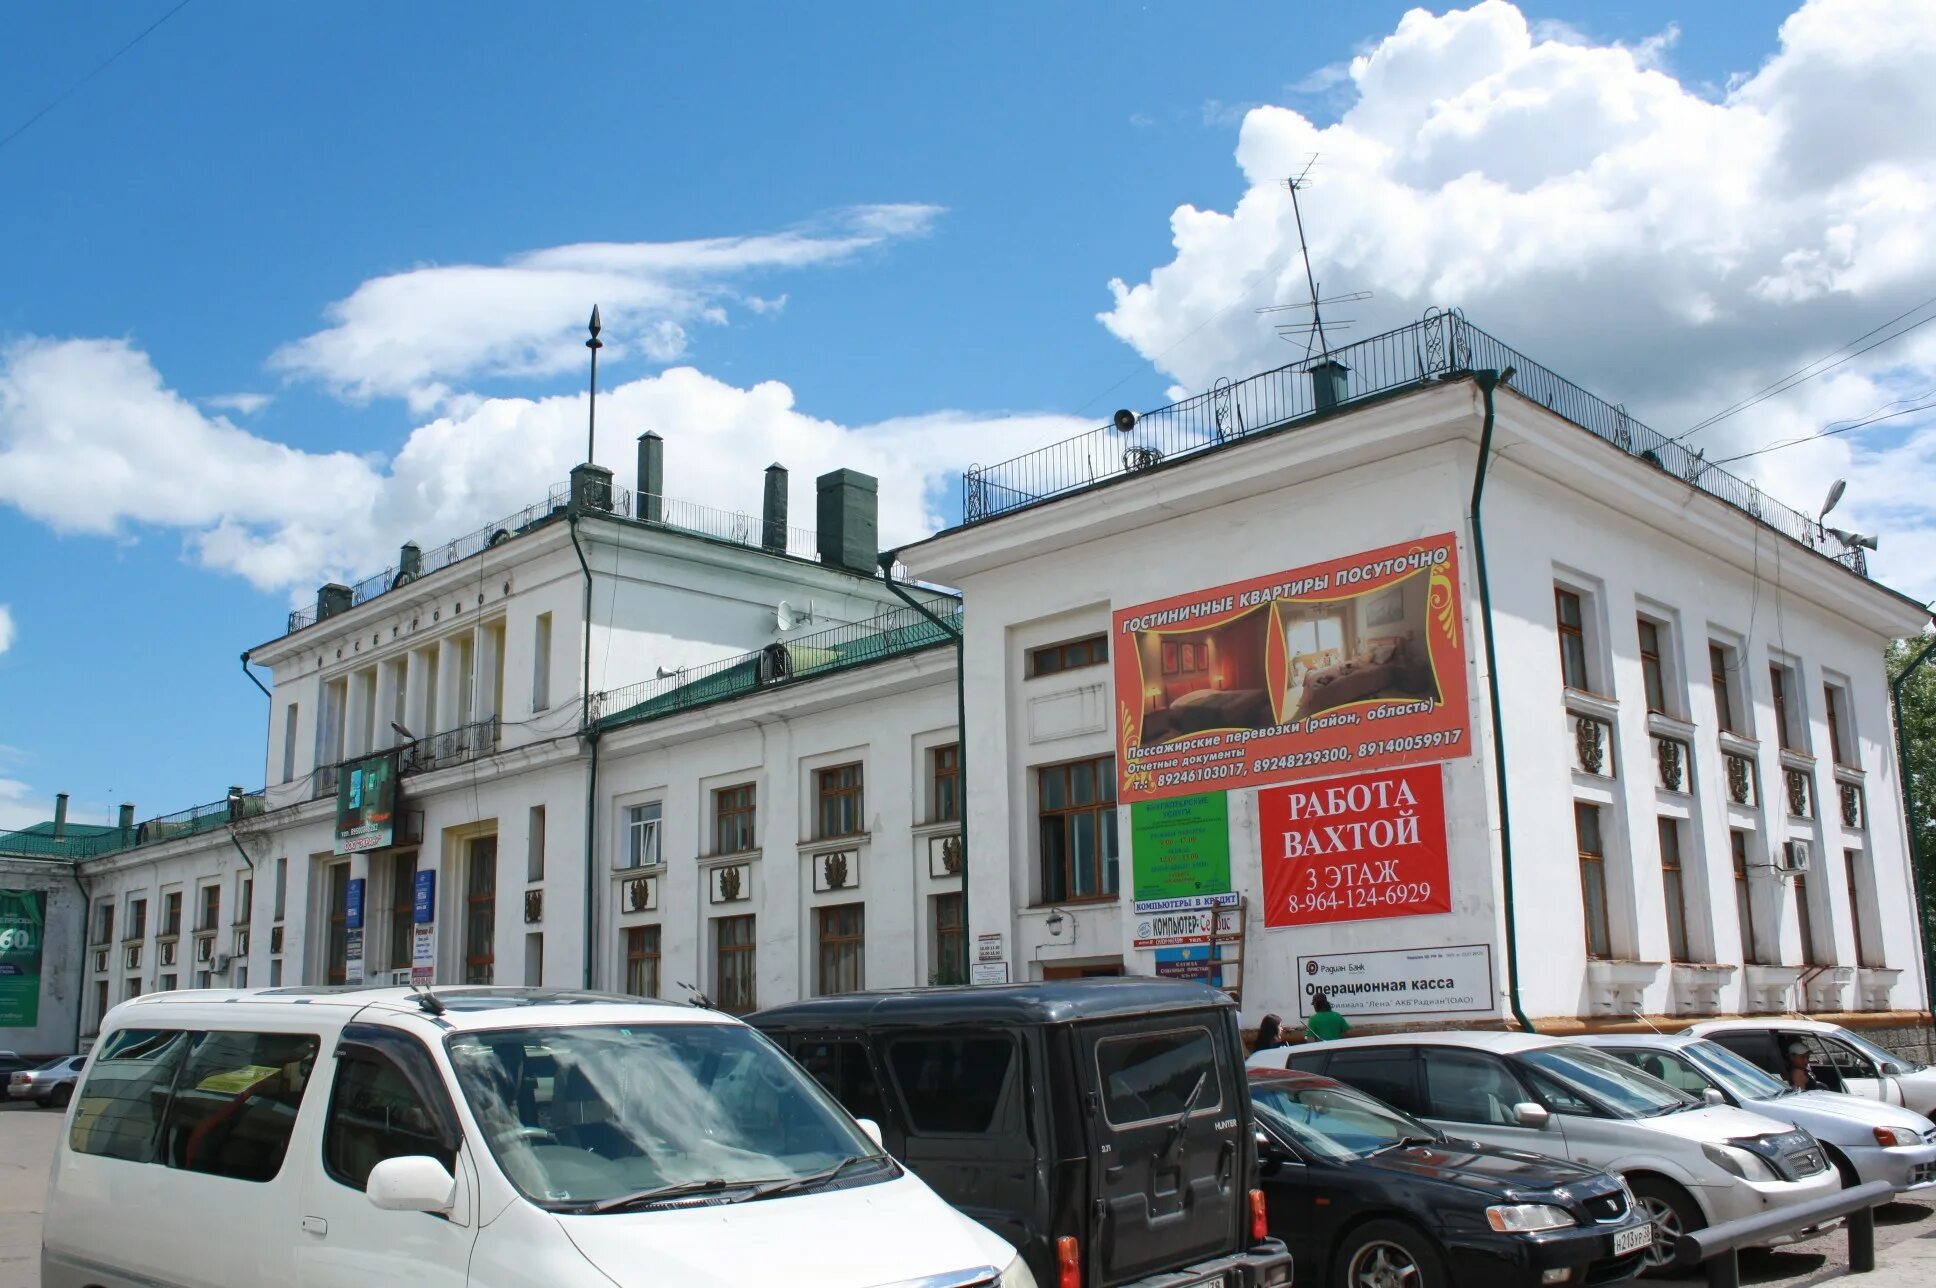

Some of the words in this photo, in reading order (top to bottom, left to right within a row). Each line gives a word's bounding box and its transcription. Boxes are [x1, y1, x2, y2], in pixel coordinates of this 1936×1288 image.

[1122, 596, 1234, 635] ГОСТИНИЧНЫЕ
[1239, 574, 1329, 608] КВАРТИРЫ
[1335, 547, 1449, 587] ПОСУТОЧНО
[1127, 733, 1221, 760] Пассажирские
[1225, 721, 1300, 746] перевозки
[1304, 713, 1361, 734] (район,
[1366, 697, 1434, 721] область)
[1127, 758, 1179, 774] Отчетные
[1181, 748, 1246, 767] документы
[1157, 763, 1249, 788] 89246103017,
[1253, 747, 1353, 774] 89248229300,
[1357, 729, 1462, 758] 89140059917
[1288, 778, 1418, 821] РАБОТА
[1282, 808, 1422, 859] ВАХТОЙ
[1305, 868, 1317, 891] 3
[1324, 859, 1401, 890] ЭТАЖ
[1136, 899, 1192, 911] КОМПЬЮТЕРЫ
[1288, 882, 1431, 914] 8-964-124-6929
[1320, 964, 1346, 975] Радиан
[1348, 962, 1366, 972] Банк
[1305, 982, 1406, 998] Операционная
[1410, 976, 1455, 991] касса
[1214, 1119, 1237, 1131] HUNTER
